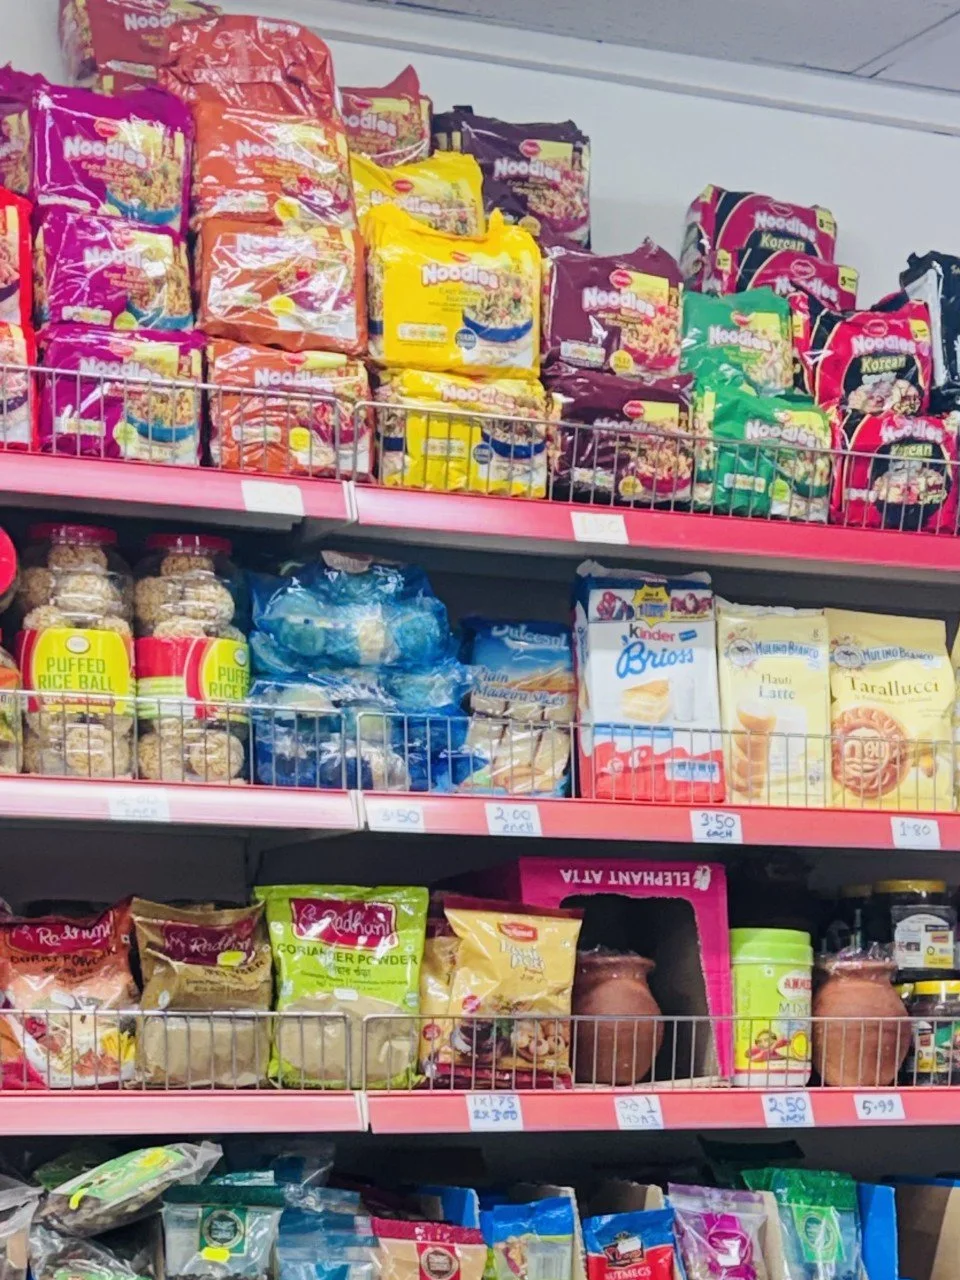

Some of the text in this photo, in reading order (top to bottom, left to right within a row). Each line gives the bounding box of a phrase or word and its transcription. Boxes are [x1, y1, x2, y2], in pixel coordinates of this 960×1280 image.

[64, 137, 149, 170] Noodles
[494, 158, 562, 181] Noodles
[754, 205, 817, 229] Noodles
[760, 234, 805, 252] Korean
[422, 263, 500, 290] Noodles
[582, 286, 655, 317] Noodles
[709, 326, 772, 351] Noodles
[852, 336, 917, 356] Noodles
[861, 355, 906, 373] Korean
[746, 421, 818, 448] Noodles
[46, 656, 106, 674] PUFFED
[616, 640, 694, 679] Brioss
[38, 673, 115, 693] RICE BALL
[209, 682, 237, 698] RICE
[845, 676, 940, 697] Tarallucci
[701, 812, 735, 830] 3.50
[560, 868, 691, 887] ELEPHANT ATTA
[322, 908, 391, 937] Radhuni
[784, 978, 812, 991] AHME
[769, 1096, 807, 1115] 2.50
[862, 1099, 895, 1116] 5.99
